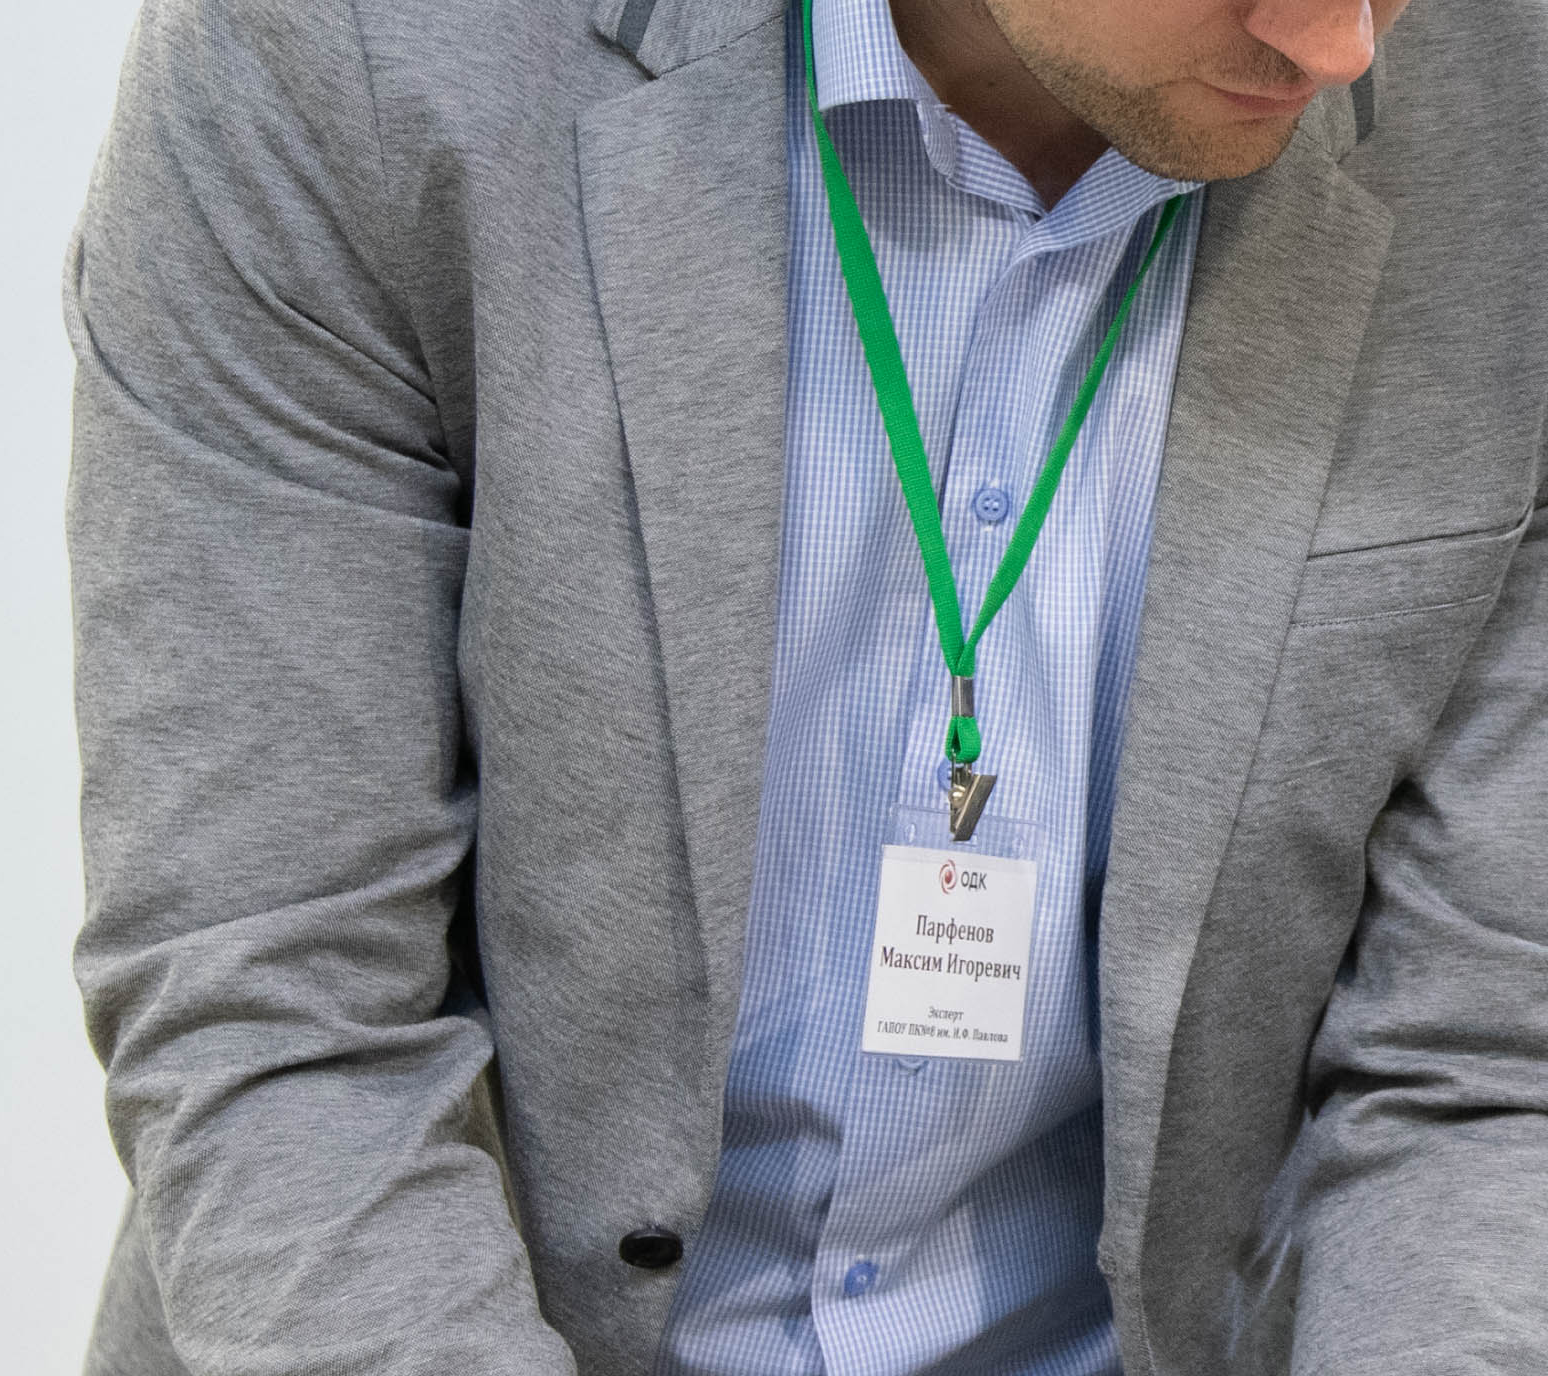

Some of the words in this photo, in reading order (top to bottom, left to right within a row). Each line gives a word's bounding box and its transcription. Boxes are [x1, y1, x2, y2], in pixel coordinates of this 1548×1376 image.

[960, 870, 987, 891] ОДК
[916, 914, 994, 944] Парфенов
[880, 946, 943, 972] Максим
[947, 952, 1021, 982] Игоревич
[928, 1006, 964, 1022] Эксперт
